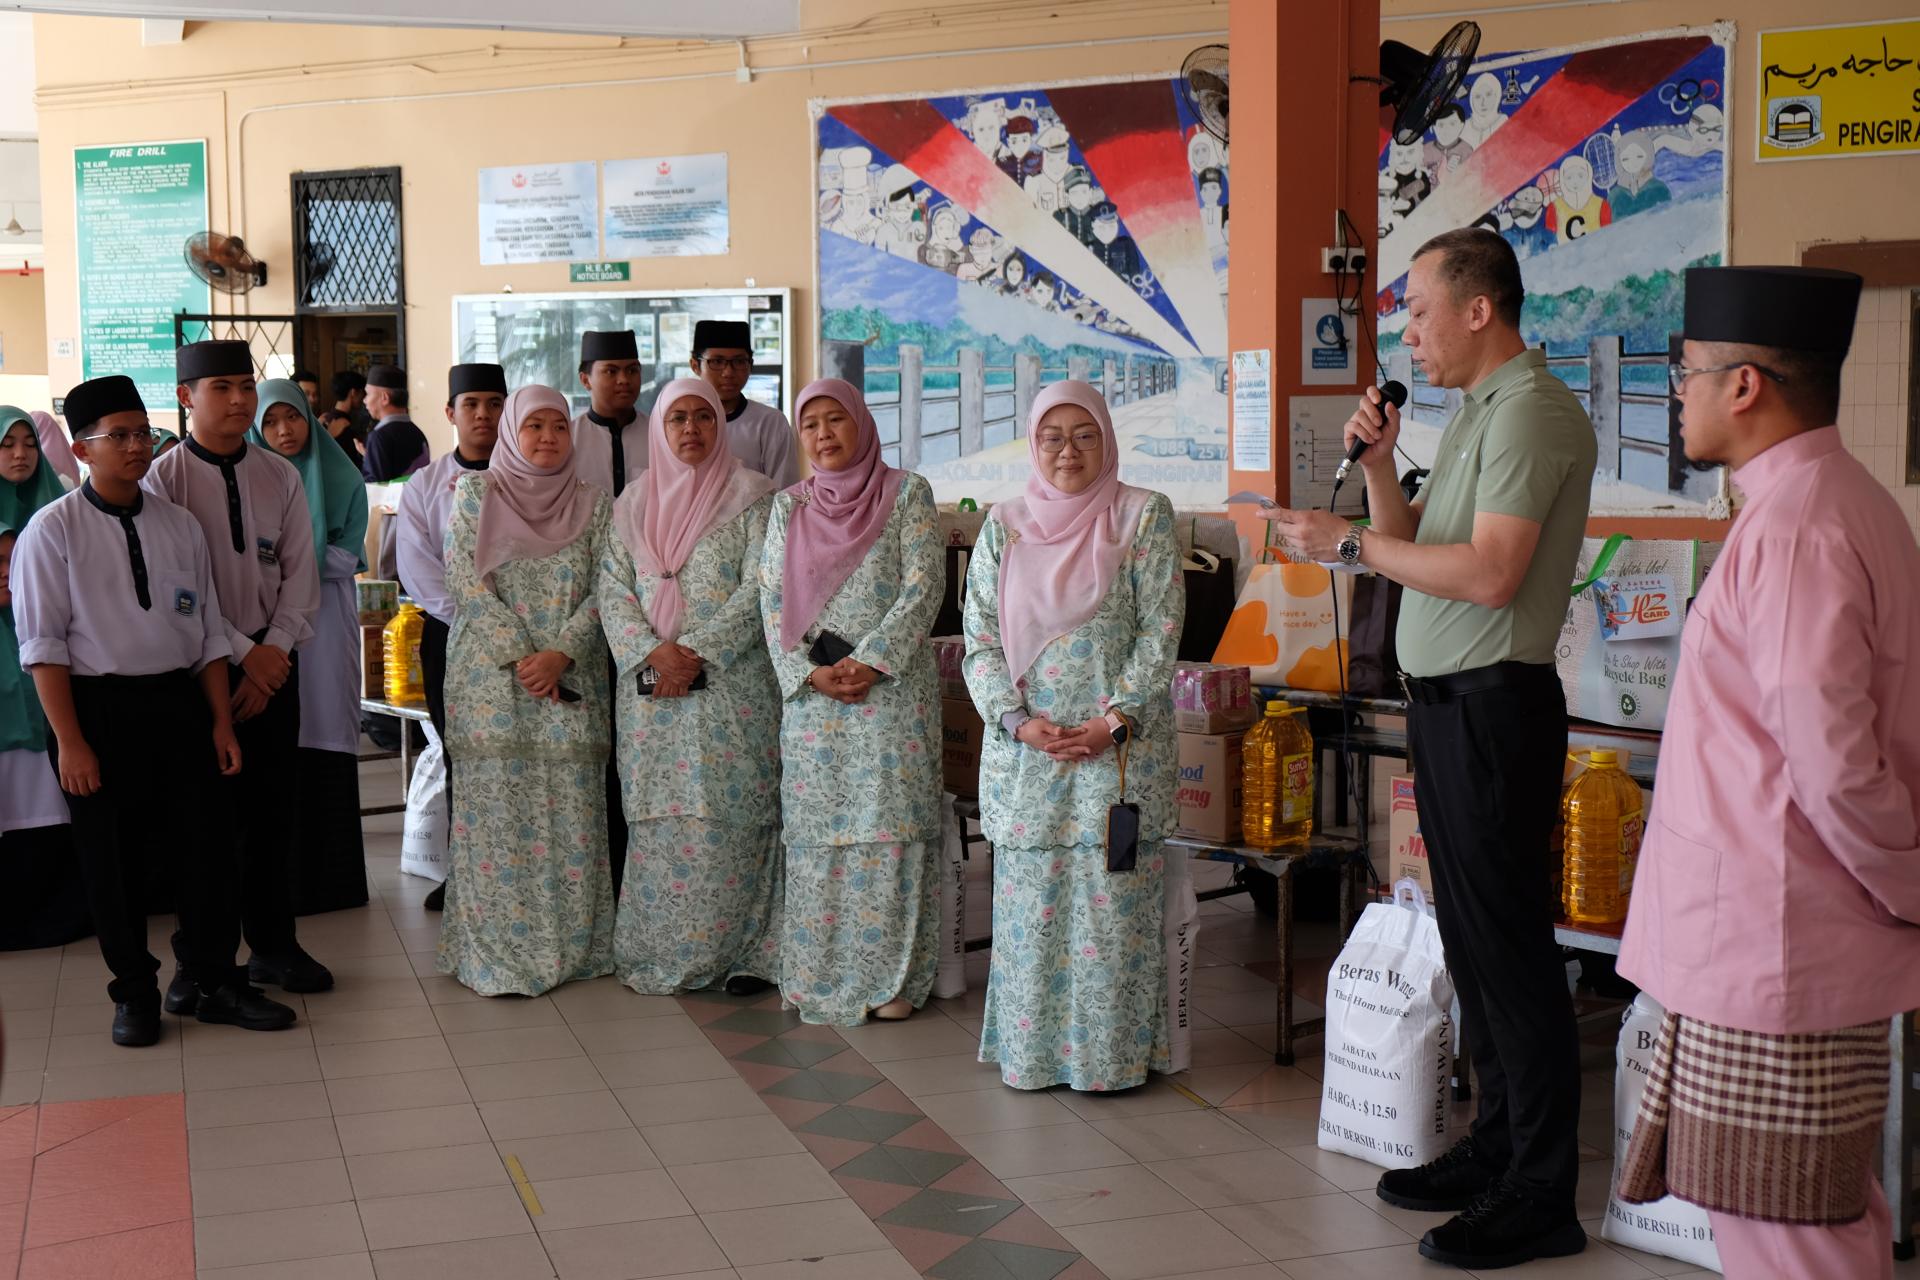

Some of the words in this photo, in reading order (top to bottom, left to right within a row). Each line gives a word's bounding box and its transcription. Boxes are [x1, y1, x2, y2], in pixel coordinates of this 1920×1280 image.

[109, 148, 133, 158] FIRE
[137, 146, 166, 157] DRILL
[576, 272, 600, 280] NOTICE
[600, 271, 623, 280] BOARD
[1152, 440, 1187, 456] 1985
[1198, 447, 1214, 459] 25
[1619, 561, 1642, 577] With
[1643, 610, 1671, 618] CARD
[1639, 671, 1668, 689] Bag
[1339, 963, 1380, 983] Beras
[1388, 969, 1417, 1000] Wang
[1178, 978, 1188, 1029] BERAS
[1334, 988, 1352, 1002] Thai
[1353, 995, 1376, 1012] Hom
[1342, 1042, 1377, 1061] JABATAN
[1328, 1051, 1401, 1081] PERBENDAHARAAN
[1625, 1056, 1649, 1075] Tha
[1328, 1086, 1356, 1110] HARGA
[1372, 1103, 1397, 1120] 12.50
[1435, 1074, 1446, 1136] BERAS
[1320, 1116, 1341, 1137] BERAT
[1343, 1127, 1376, 1150] BERSIH
[1383, 1141, 1393, 1154] 10
[1395, 1143, 1414, 1158] KG
[1608, 1203, 1634, 1226] BERAT
[1636, 1215, 1681, 1237] BERSIH
[1692, 1226, 1705, 1240] 10
